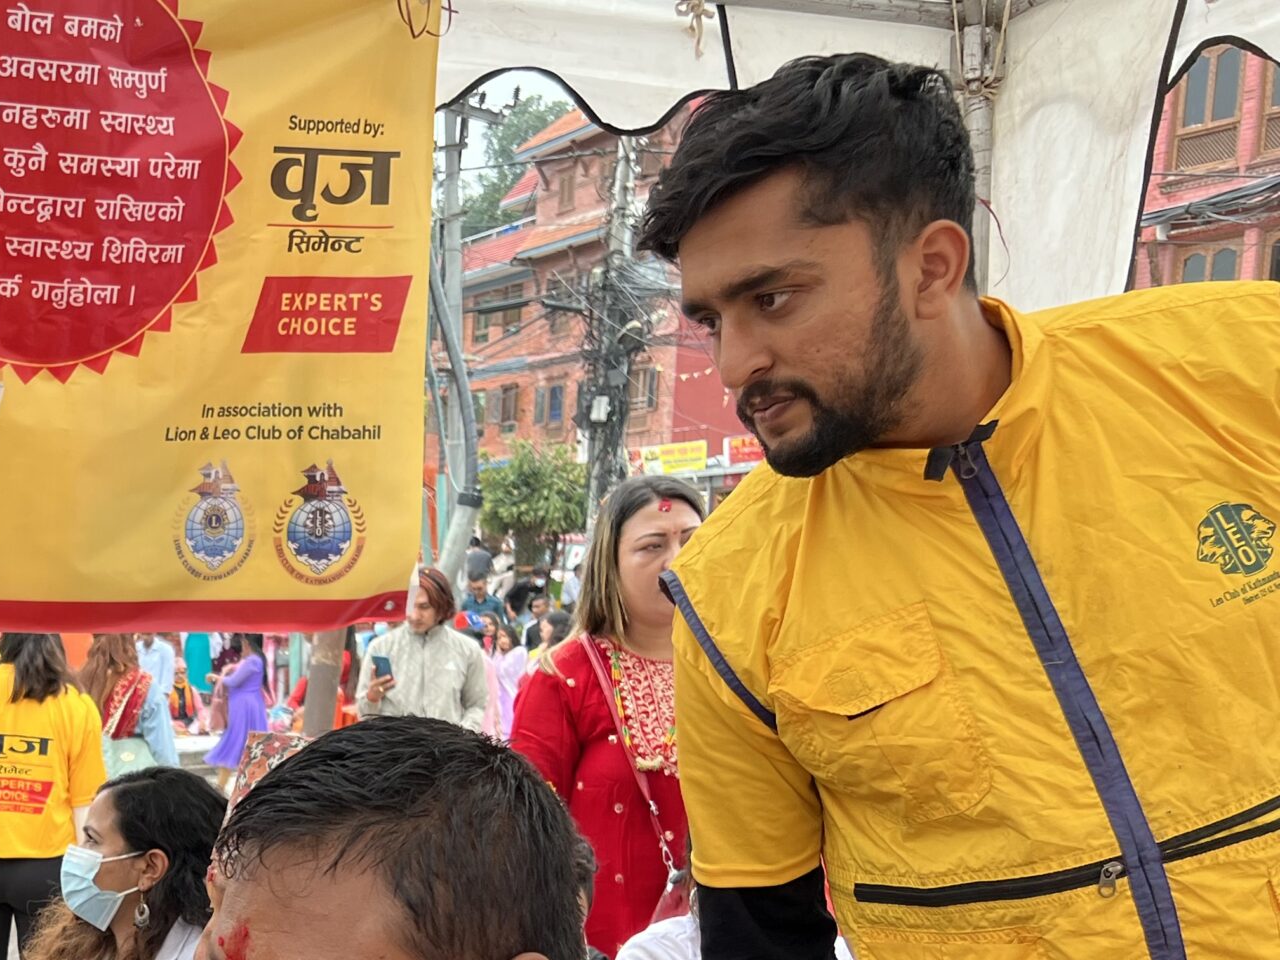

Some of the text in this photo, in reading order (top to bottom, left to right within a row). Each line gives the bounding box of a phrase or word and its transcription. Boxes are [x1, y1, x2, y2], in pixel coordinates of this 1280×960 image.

[7, 3, 123, 43] बोल बमको
[108, 66, 167, 99] सम्पुर्ण
[99, 110, 175, 136] स्वास्थ्य
[288, 115, 385, 139] Supported by:
[3, 142, 48, 177] कुनै
[58, 152, 140, 179] समस्या
[148, 152, 202, 180] परेमा
[270, 145, 401, 222] वृज
[95, 193, 185, 222] राखिएको
[5, 235, 94, 263] स्वास्थ्य
[101, 236, 185, 264] शिविरमा
[287, 228, 365, 254] सिमेन्ट
[31, 277, 120, 309] गर्नुहोला
[280, 292, 383, 312] EXPERT'S
[277, 317, 357, 336] CHOICE
[201, 402, 343, 418] In association with
[165, 425, 381, 442] Lion & Leo Club of Chabahil
[1214, 510, 1257, 567] LEO
